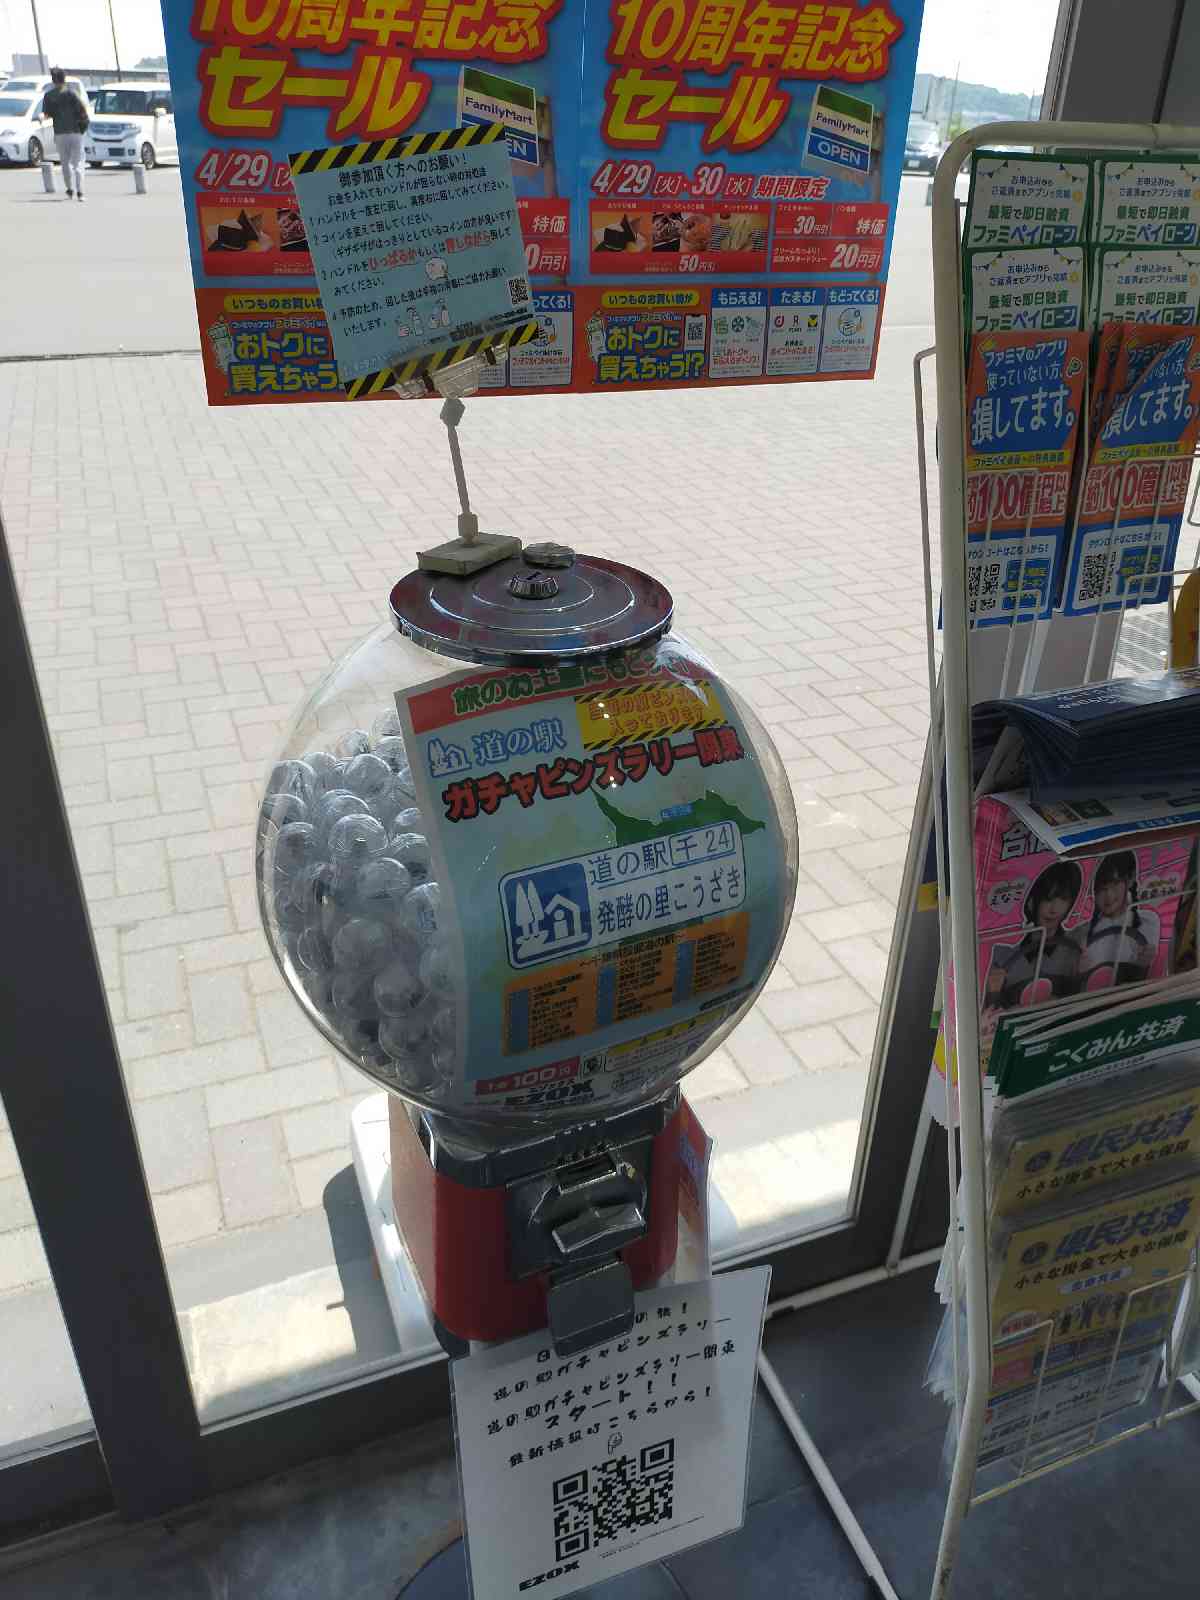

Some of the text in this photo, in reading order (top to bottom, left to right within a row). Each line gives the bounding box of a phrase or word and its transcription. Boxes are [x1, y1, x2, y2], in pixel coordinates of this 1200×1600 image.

[611, 0, 898, 73] 10周年記念
[207, 46, 423, 133] セール
[464, 96, 533, 126] FamilyMart
[609, 68, 784, 145] セール
[816, 111, 869, 138] FamilyMart
[817, 141, 861, 166] OPEN
[533, 214, 567, 234] 特価
[855, 217, 886, 235] 特価
[234, 332, 329, 360] おトクに
[607, 324, 681, 352] おトクに
[984, 337, 1068, 367] ファミマのアプリ
[472, 718, 568, 768] 道の駅
[588, 839, 670, 887] 道の駅
[596, 864, 742, 936] 発酵の里こうざき
[1049, 1014, 1188, 1073] こくみん共済
[517, 1560, 581, 1593] EZOX
